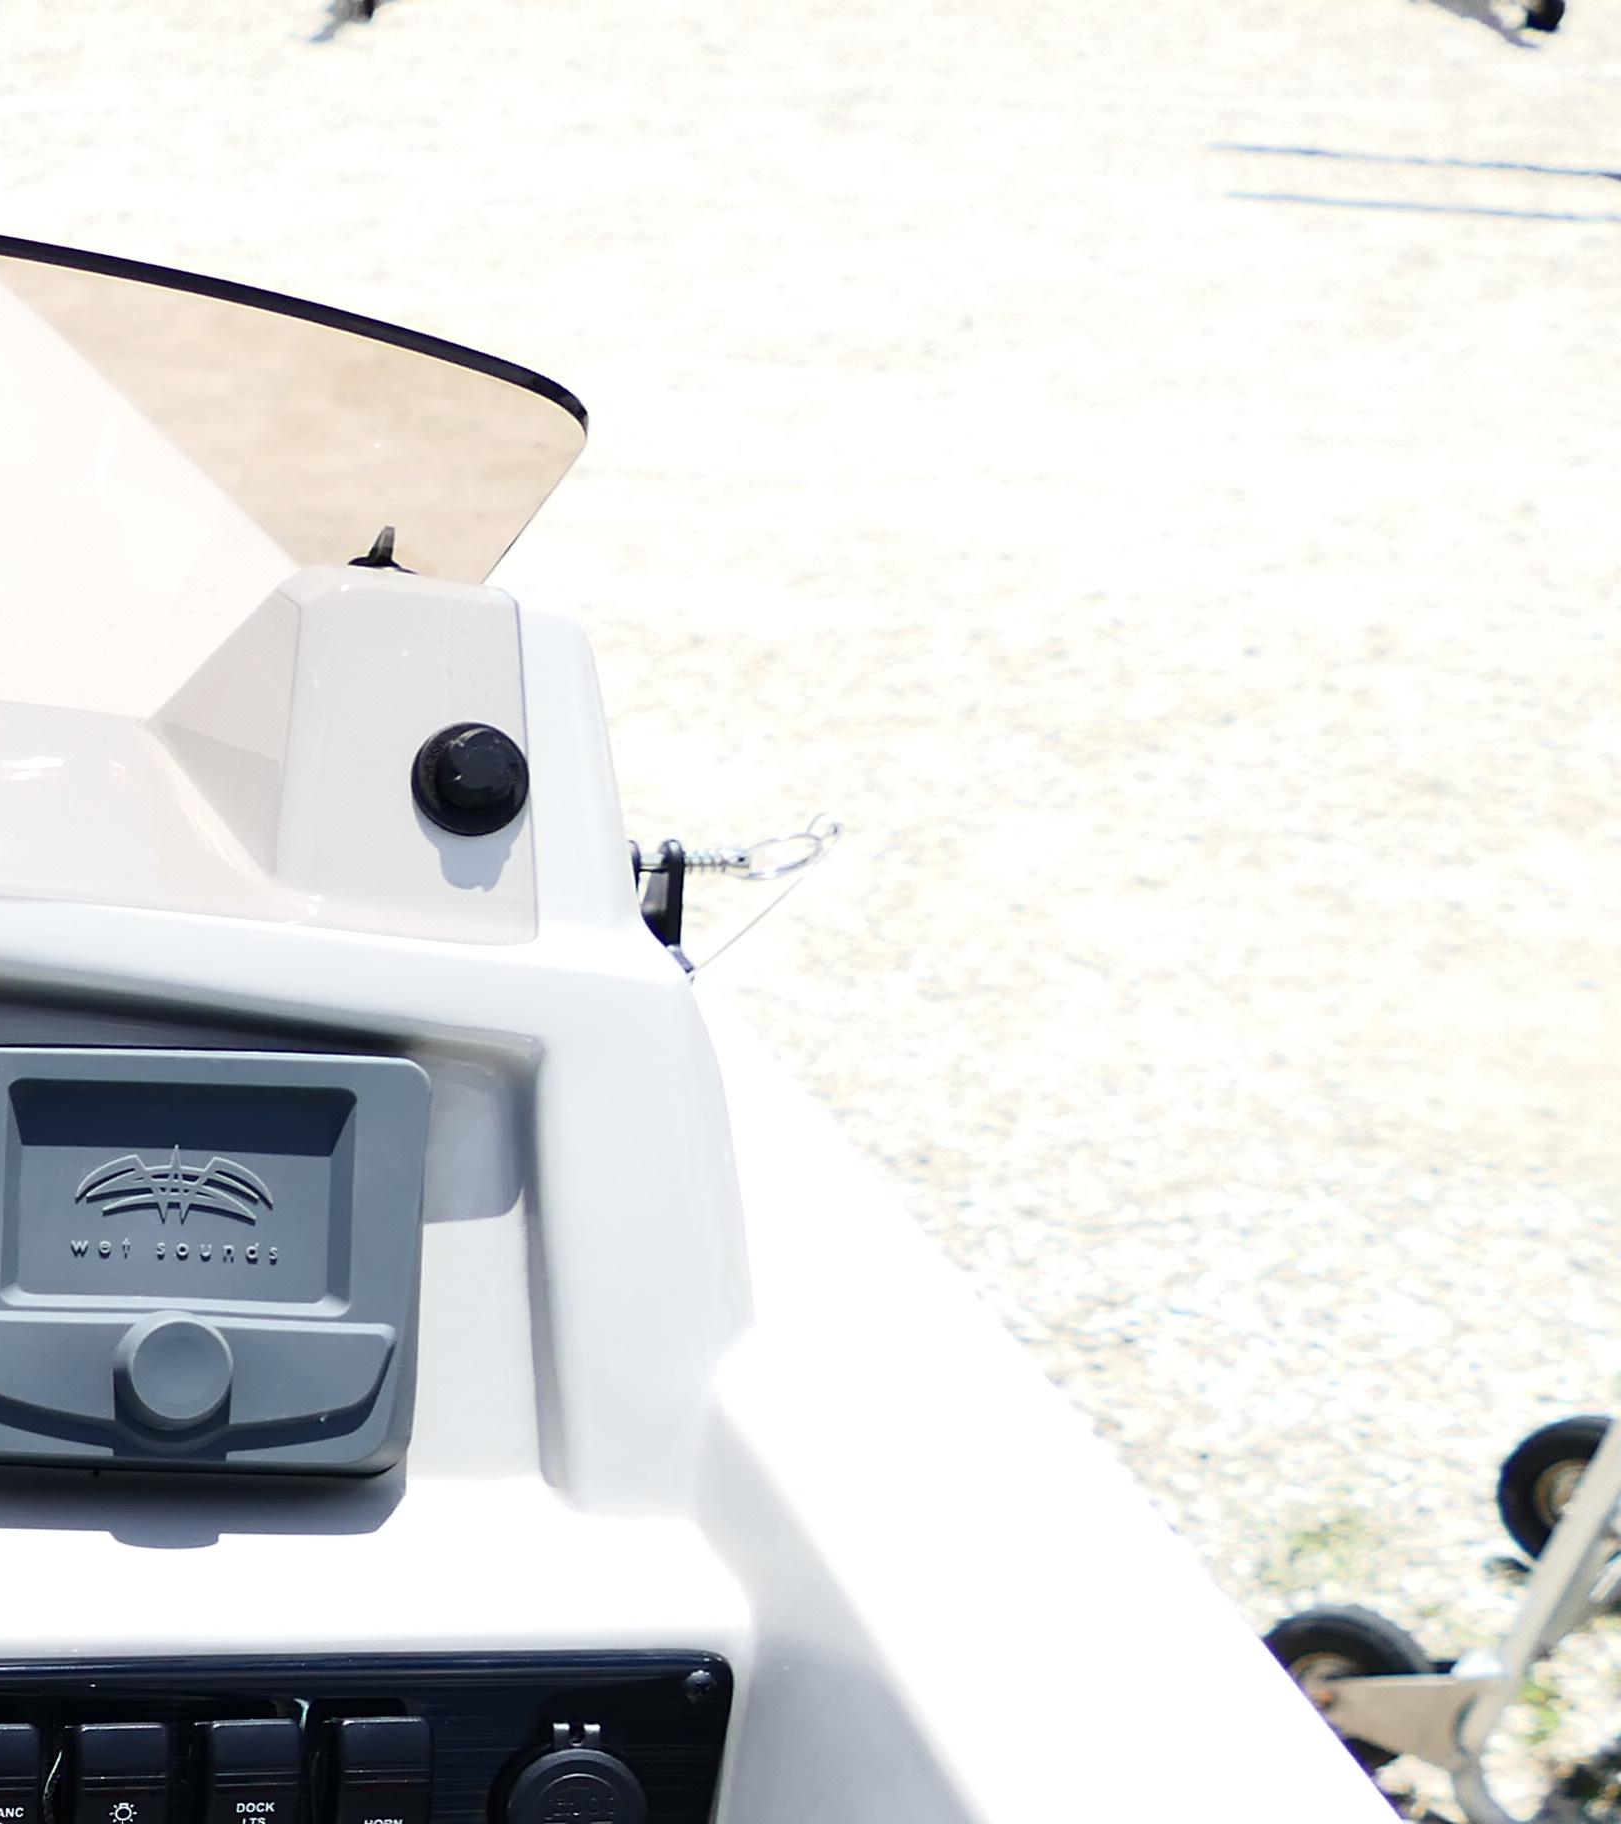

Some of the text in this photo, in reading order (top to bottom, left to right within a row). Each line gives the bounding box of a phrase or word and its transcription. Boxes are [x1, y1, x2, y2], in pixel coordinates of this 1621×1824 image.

[71, 1236, 280, 1265] wet sounds
[236, 1802, 276, 1813] DOCK
